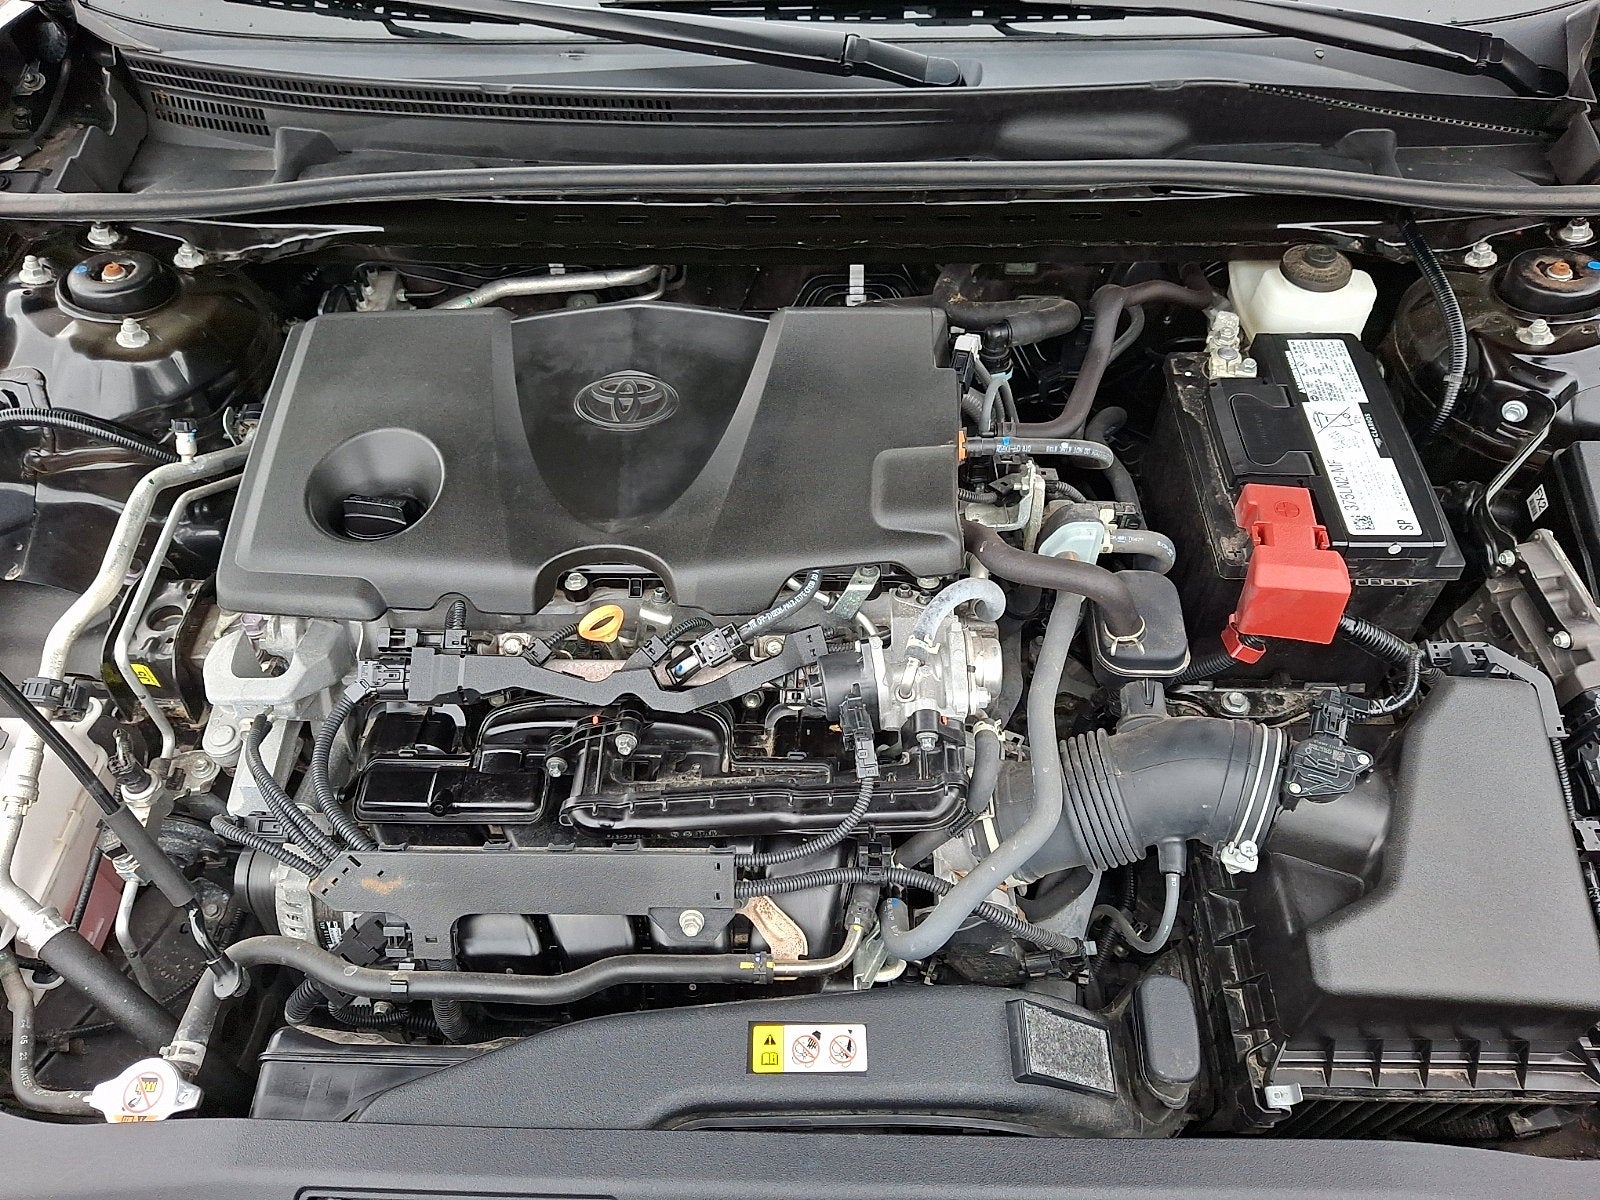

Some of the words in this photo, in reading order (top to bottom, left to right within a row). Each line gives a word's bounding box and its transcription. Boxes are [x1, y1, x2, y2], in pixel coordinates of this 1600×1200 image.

[1327, 460, 1359, 511] 375LN2-MF
[1534, 488, 1546, 512] FX2
[1397, 519, 1414, 531] SP
